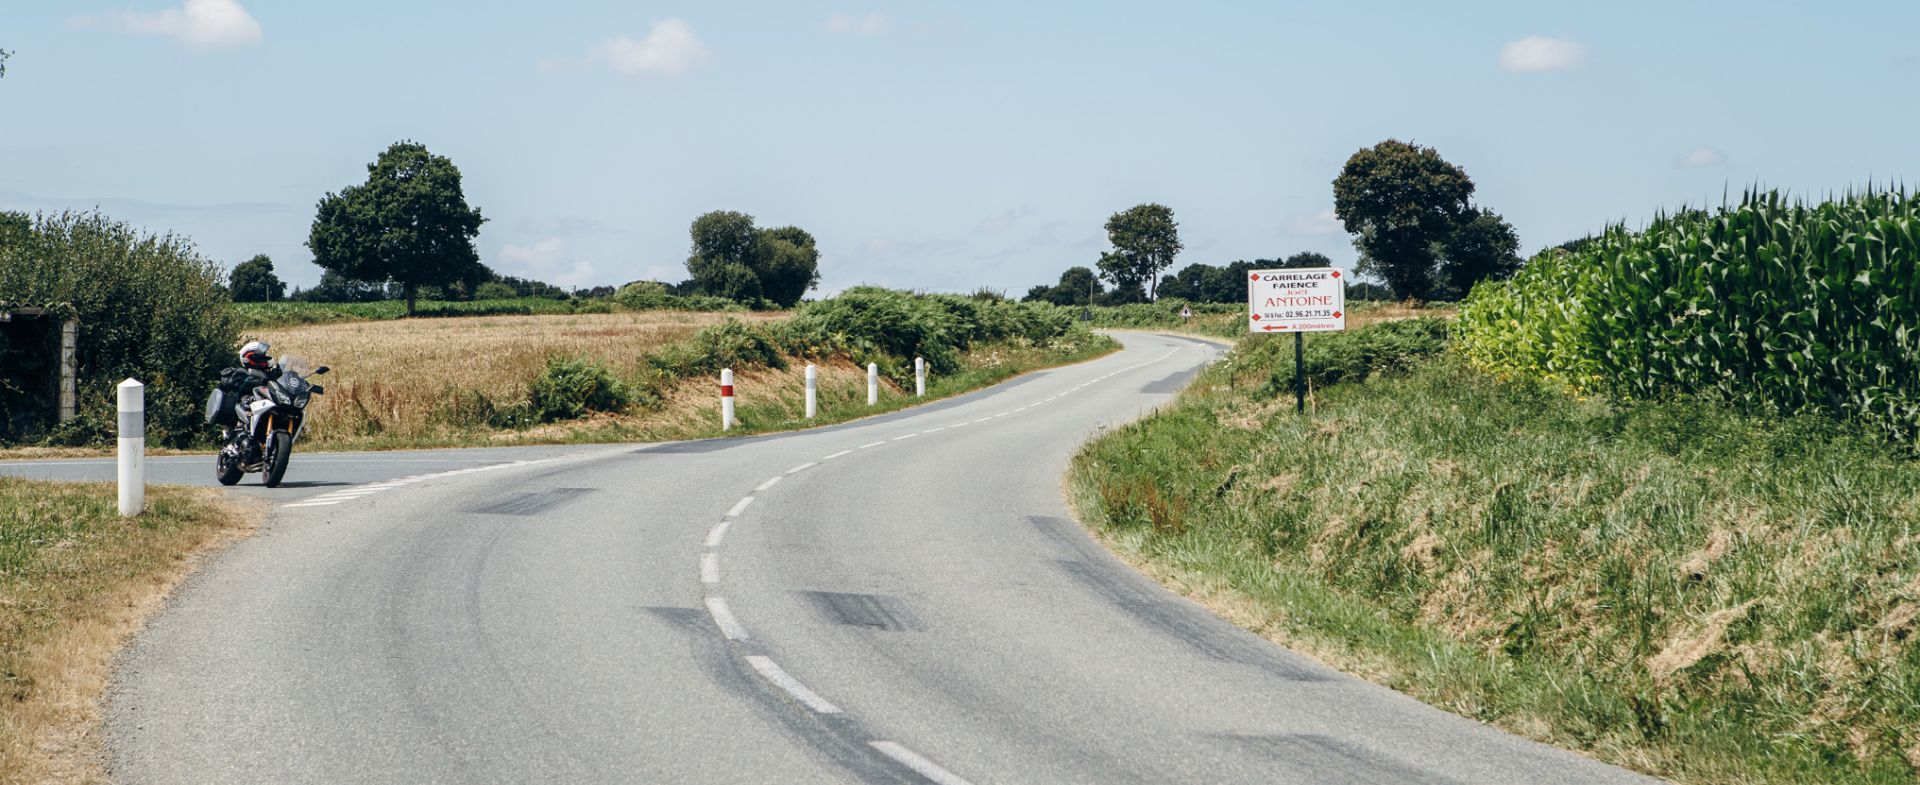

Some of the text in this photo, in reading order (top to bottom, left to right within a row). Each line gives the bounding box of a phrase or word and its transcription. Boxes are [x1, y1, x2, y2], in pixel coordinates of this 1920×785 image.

[1263, 273, 1328, 282] CARRELAGE
[1273, 281, 1319, 289] FAIENCE
[1264, 295, 1333, 307] ANTOINE
[1285, 309, 1331, 318] 02.96.21.71.35
